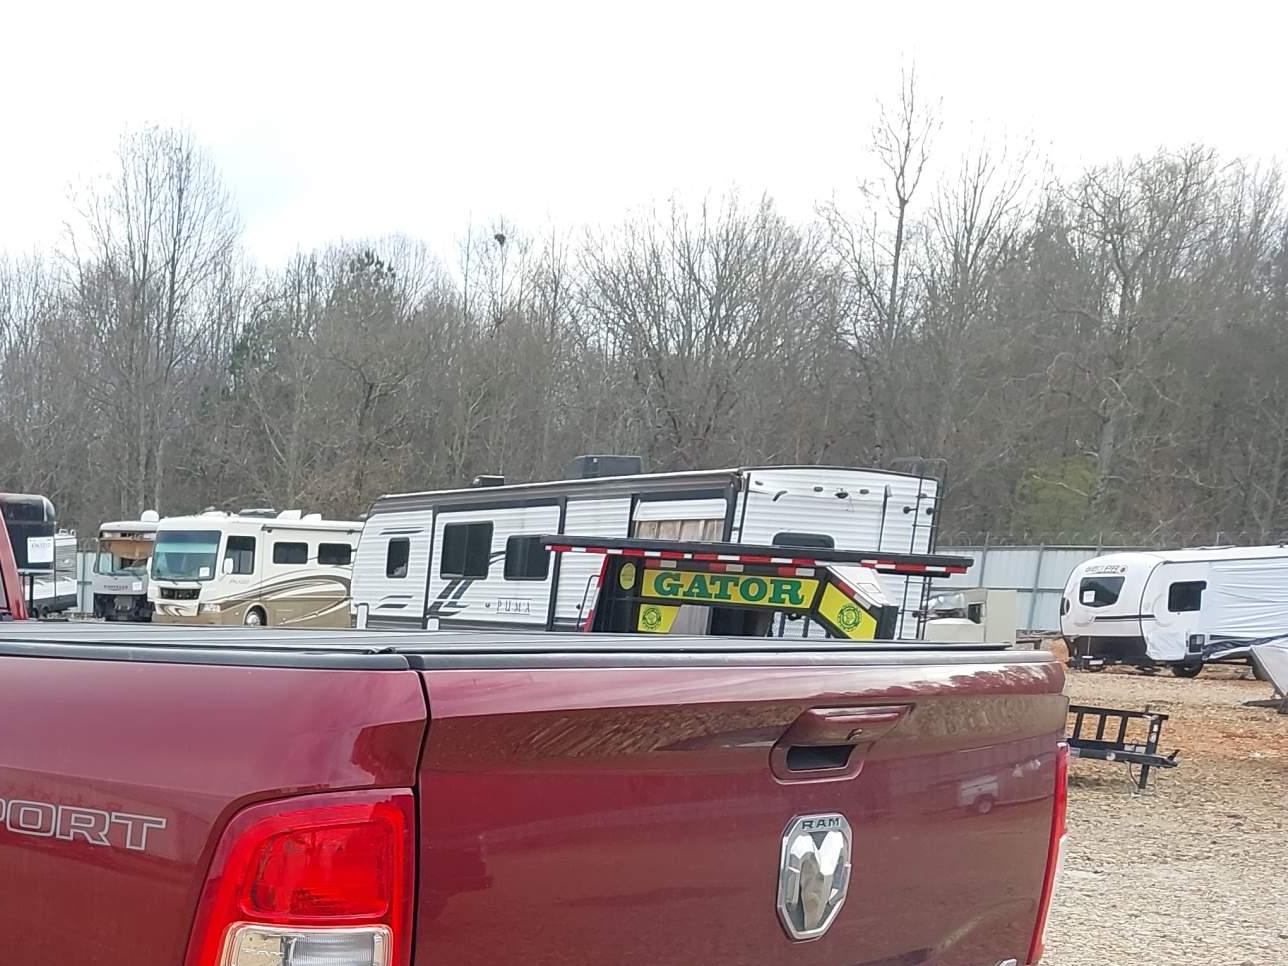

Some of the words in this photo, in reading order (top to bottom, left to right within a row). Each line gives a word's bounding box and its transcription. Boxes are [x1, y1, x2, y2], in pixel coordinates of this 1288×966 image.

[653, 571, 804, 606] GATOR
[496, 599, 530, 612] PUMA
[802, 817, 841, 830] RAM
